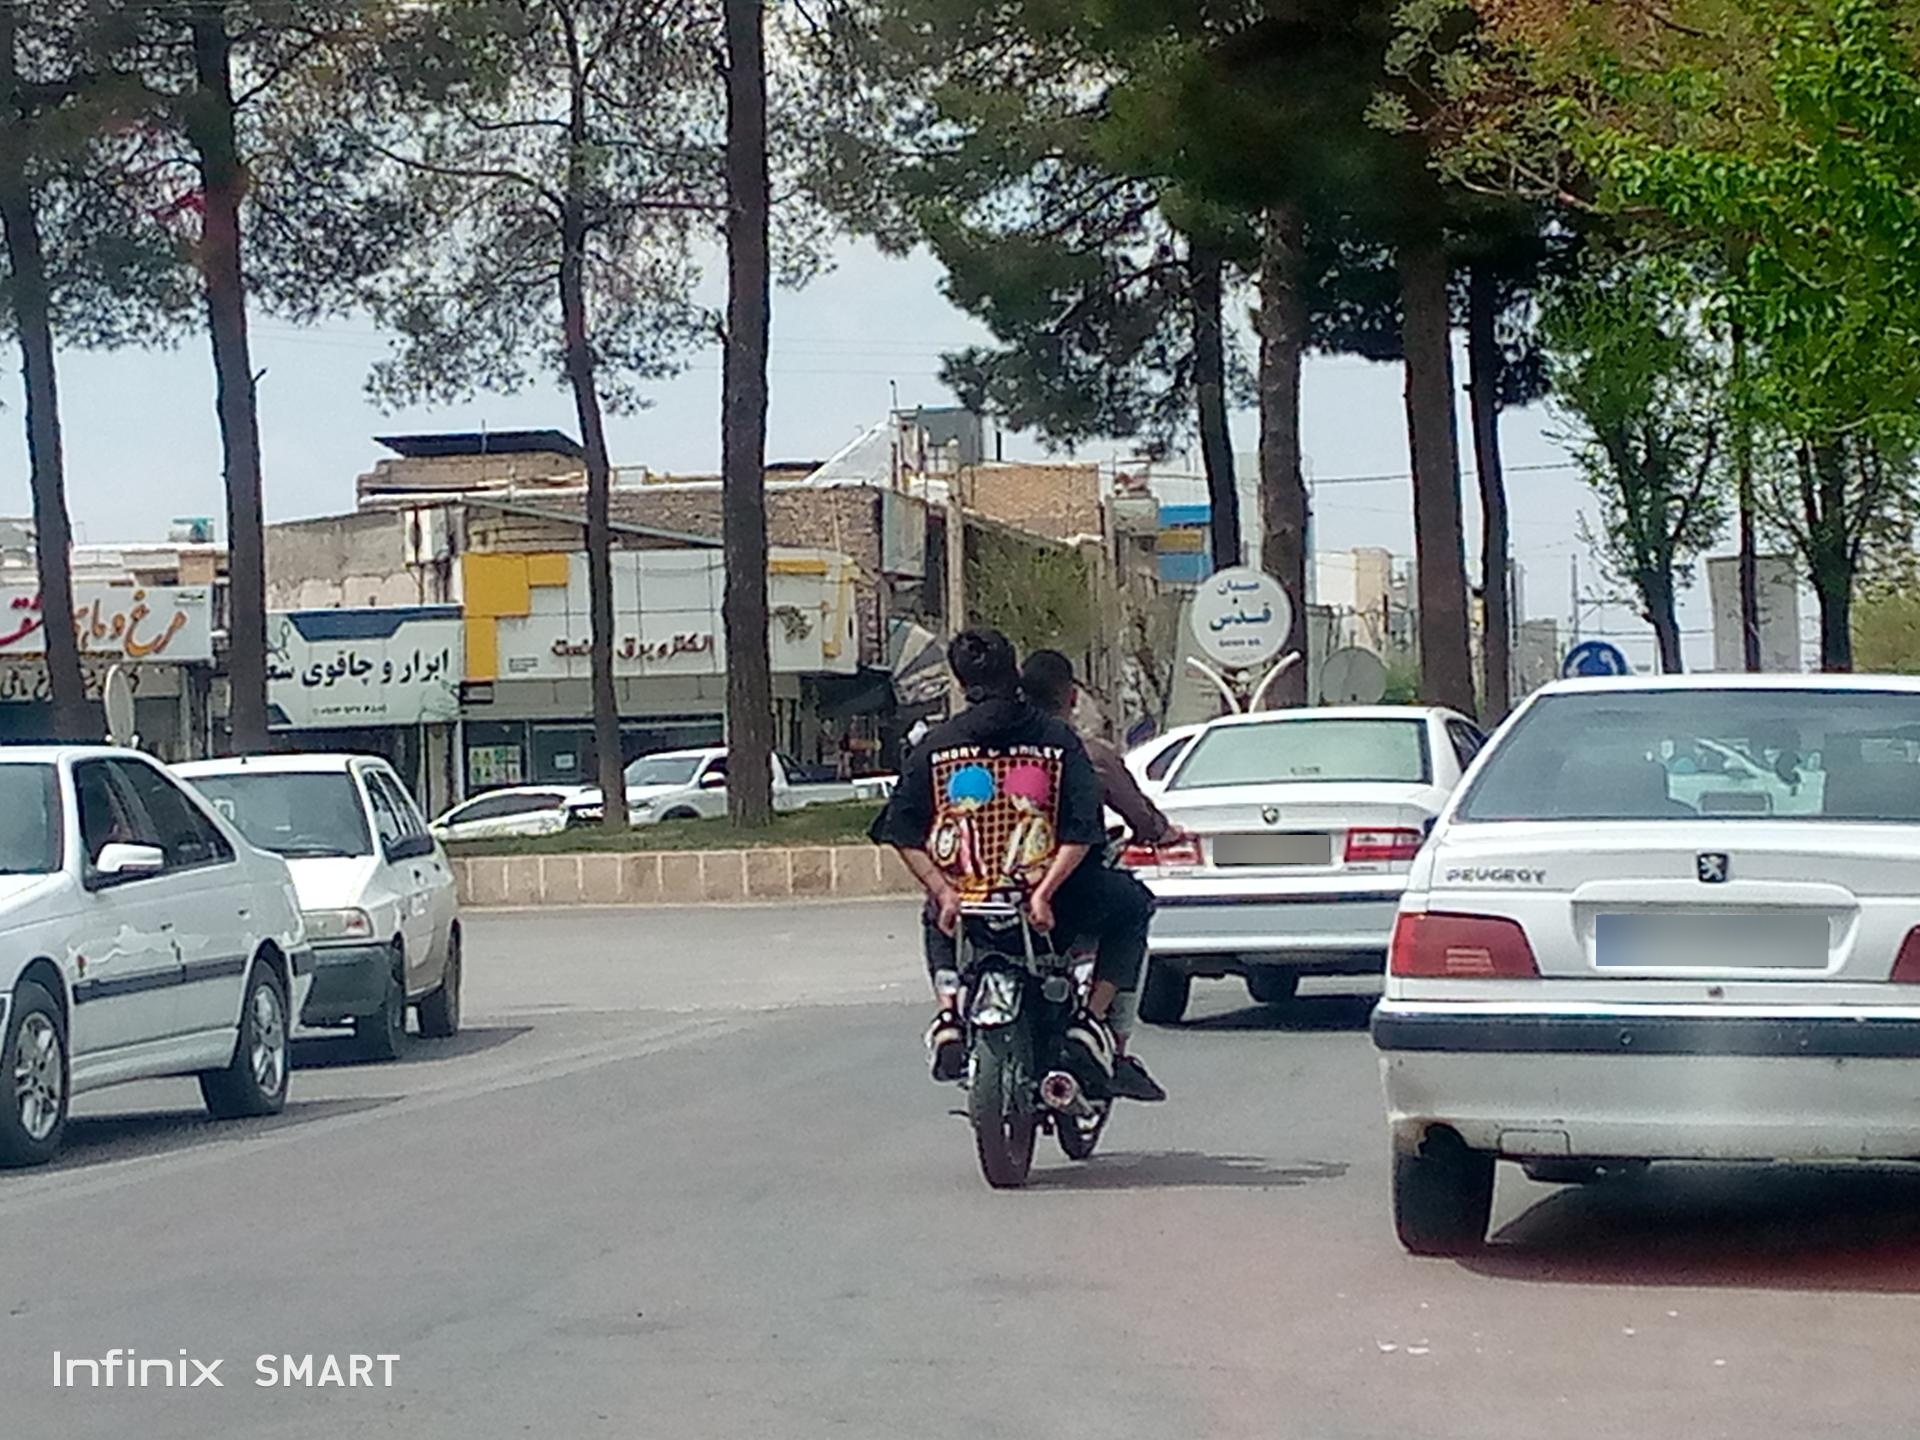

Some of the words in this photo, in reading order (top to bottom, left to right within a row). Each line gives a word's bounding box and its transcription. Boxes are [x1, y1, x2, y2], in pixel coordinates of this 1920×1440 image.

[124, 590, 187, 657] مرغ
[1209, 602, 1272, 631] قدس
[552, 638, 593, 657] نعت
[302, 650, 373, 687] چاقوی
[380, 660, 393, 683] و
[1446, 868, 1546, 885] PEUGEOT
